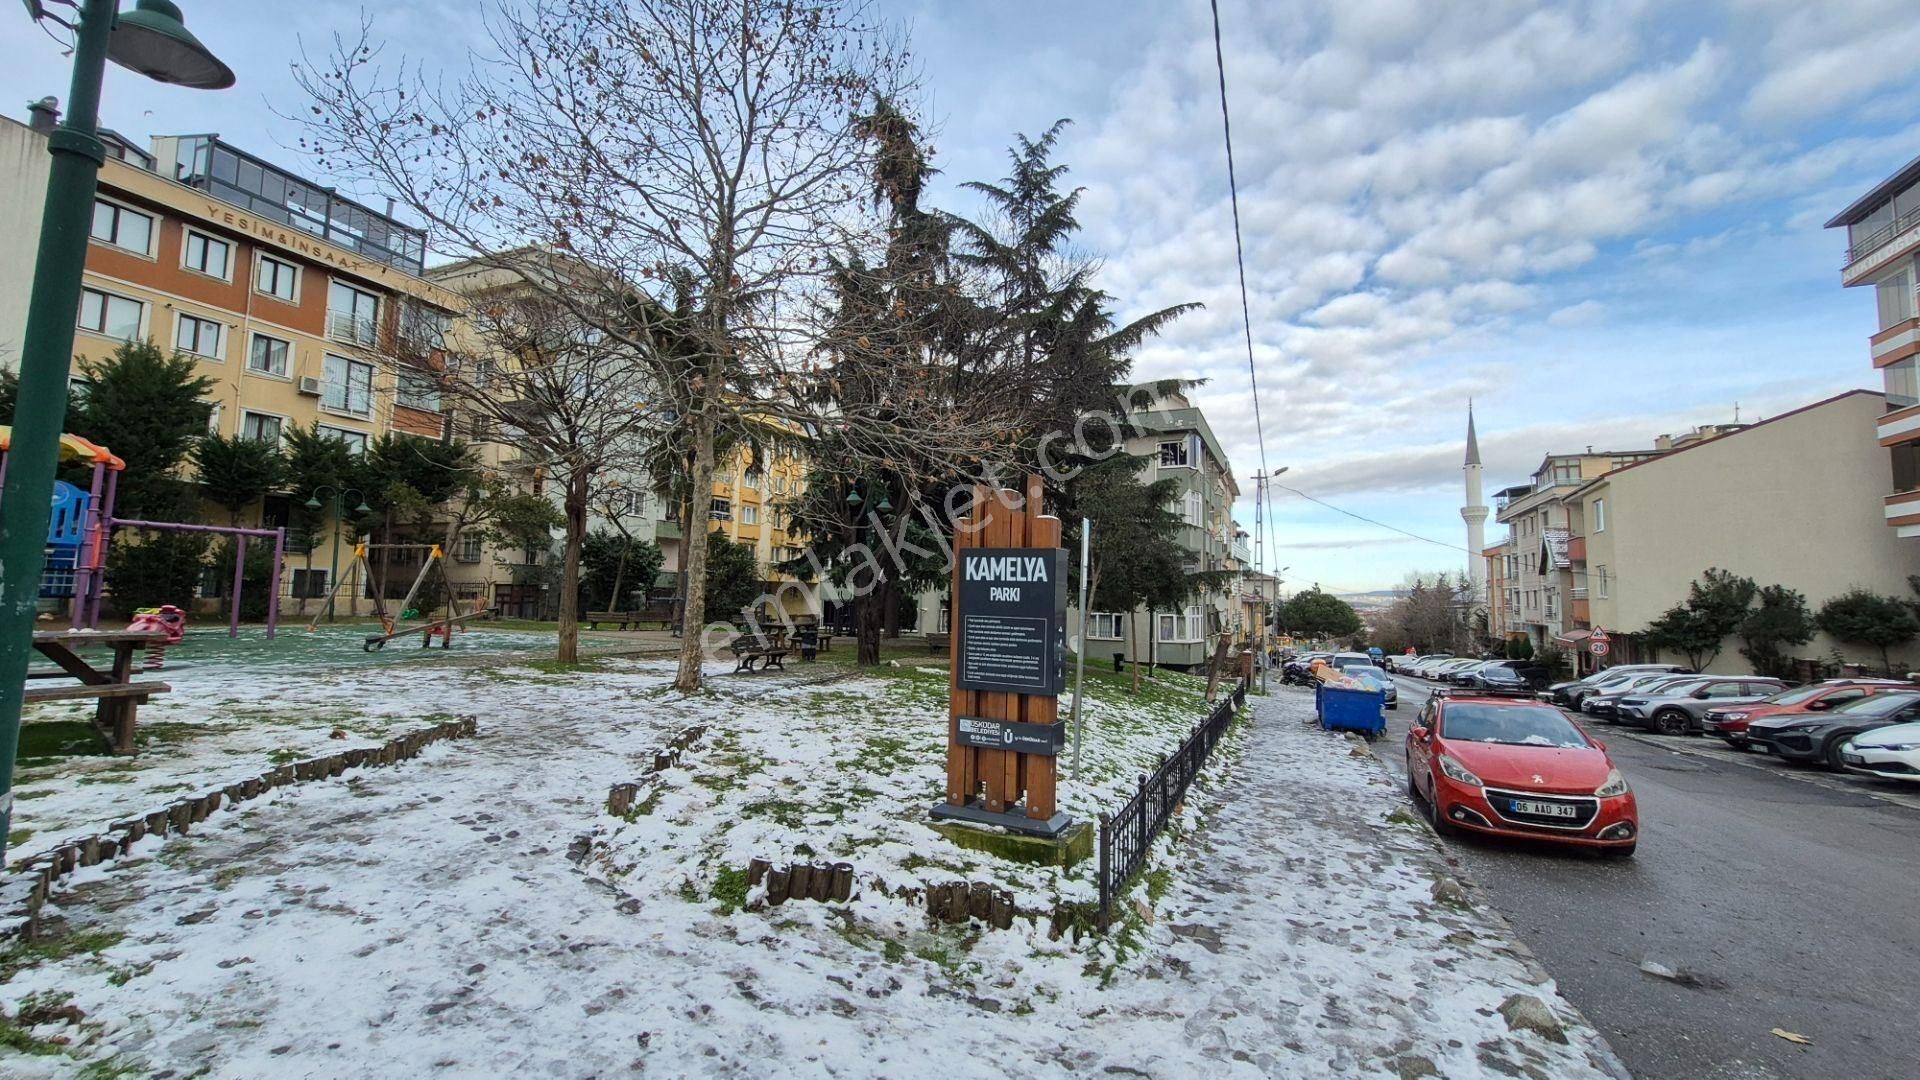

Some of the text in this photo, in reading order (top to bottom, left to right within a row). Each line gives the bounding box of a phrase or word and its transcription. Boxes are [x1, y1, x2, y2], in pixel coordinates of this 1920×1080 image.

[966, 557, 1048, 582] KAMELYA
[990, 587, 1020, 602] PARKI
[1594, 644, 1604, 652] 20
[1516, 803, 1528, 811] 06
[1557, 806, 1573, 816] 347
